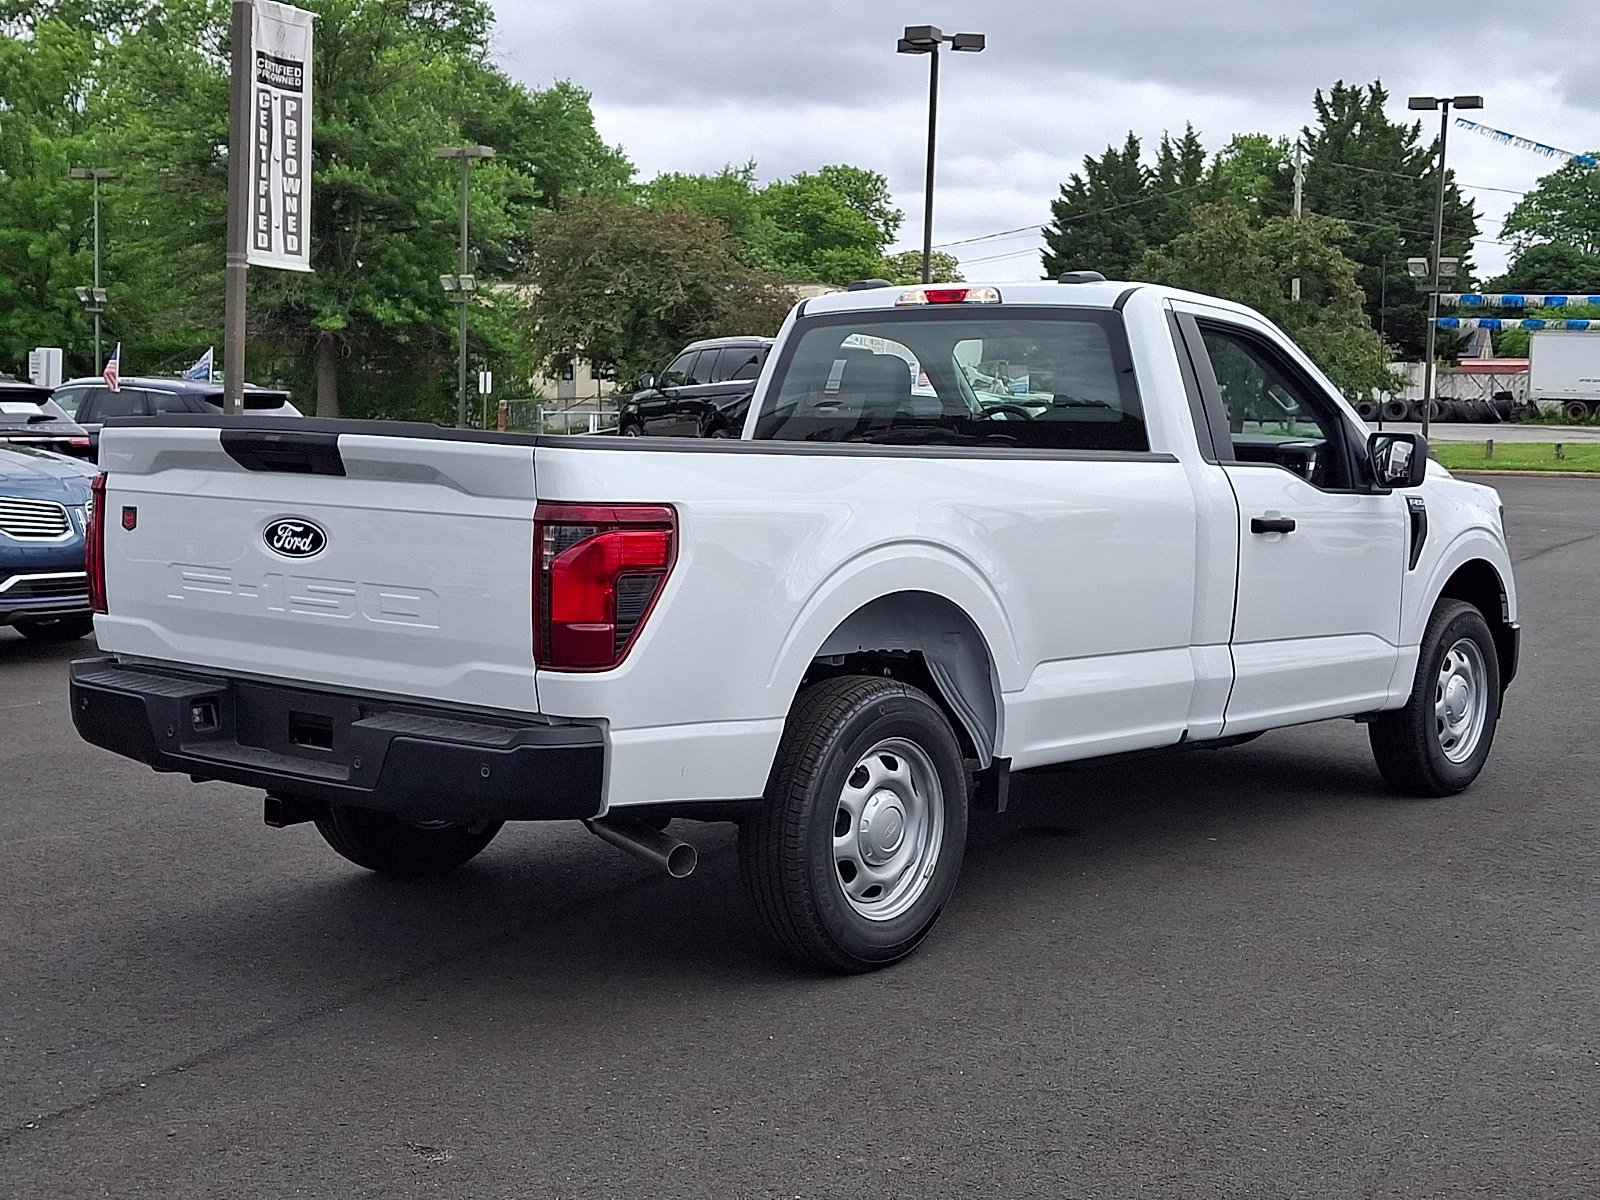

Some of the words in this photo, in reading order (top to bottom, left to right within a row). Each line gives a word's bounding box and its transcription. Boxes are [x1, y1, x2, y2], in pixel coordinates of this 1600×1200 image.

[258, 92, 270, 249] CERTIFIED
[283, 100, 301, 252] PREOWNED
[273, 523, 315, 552] Ford
